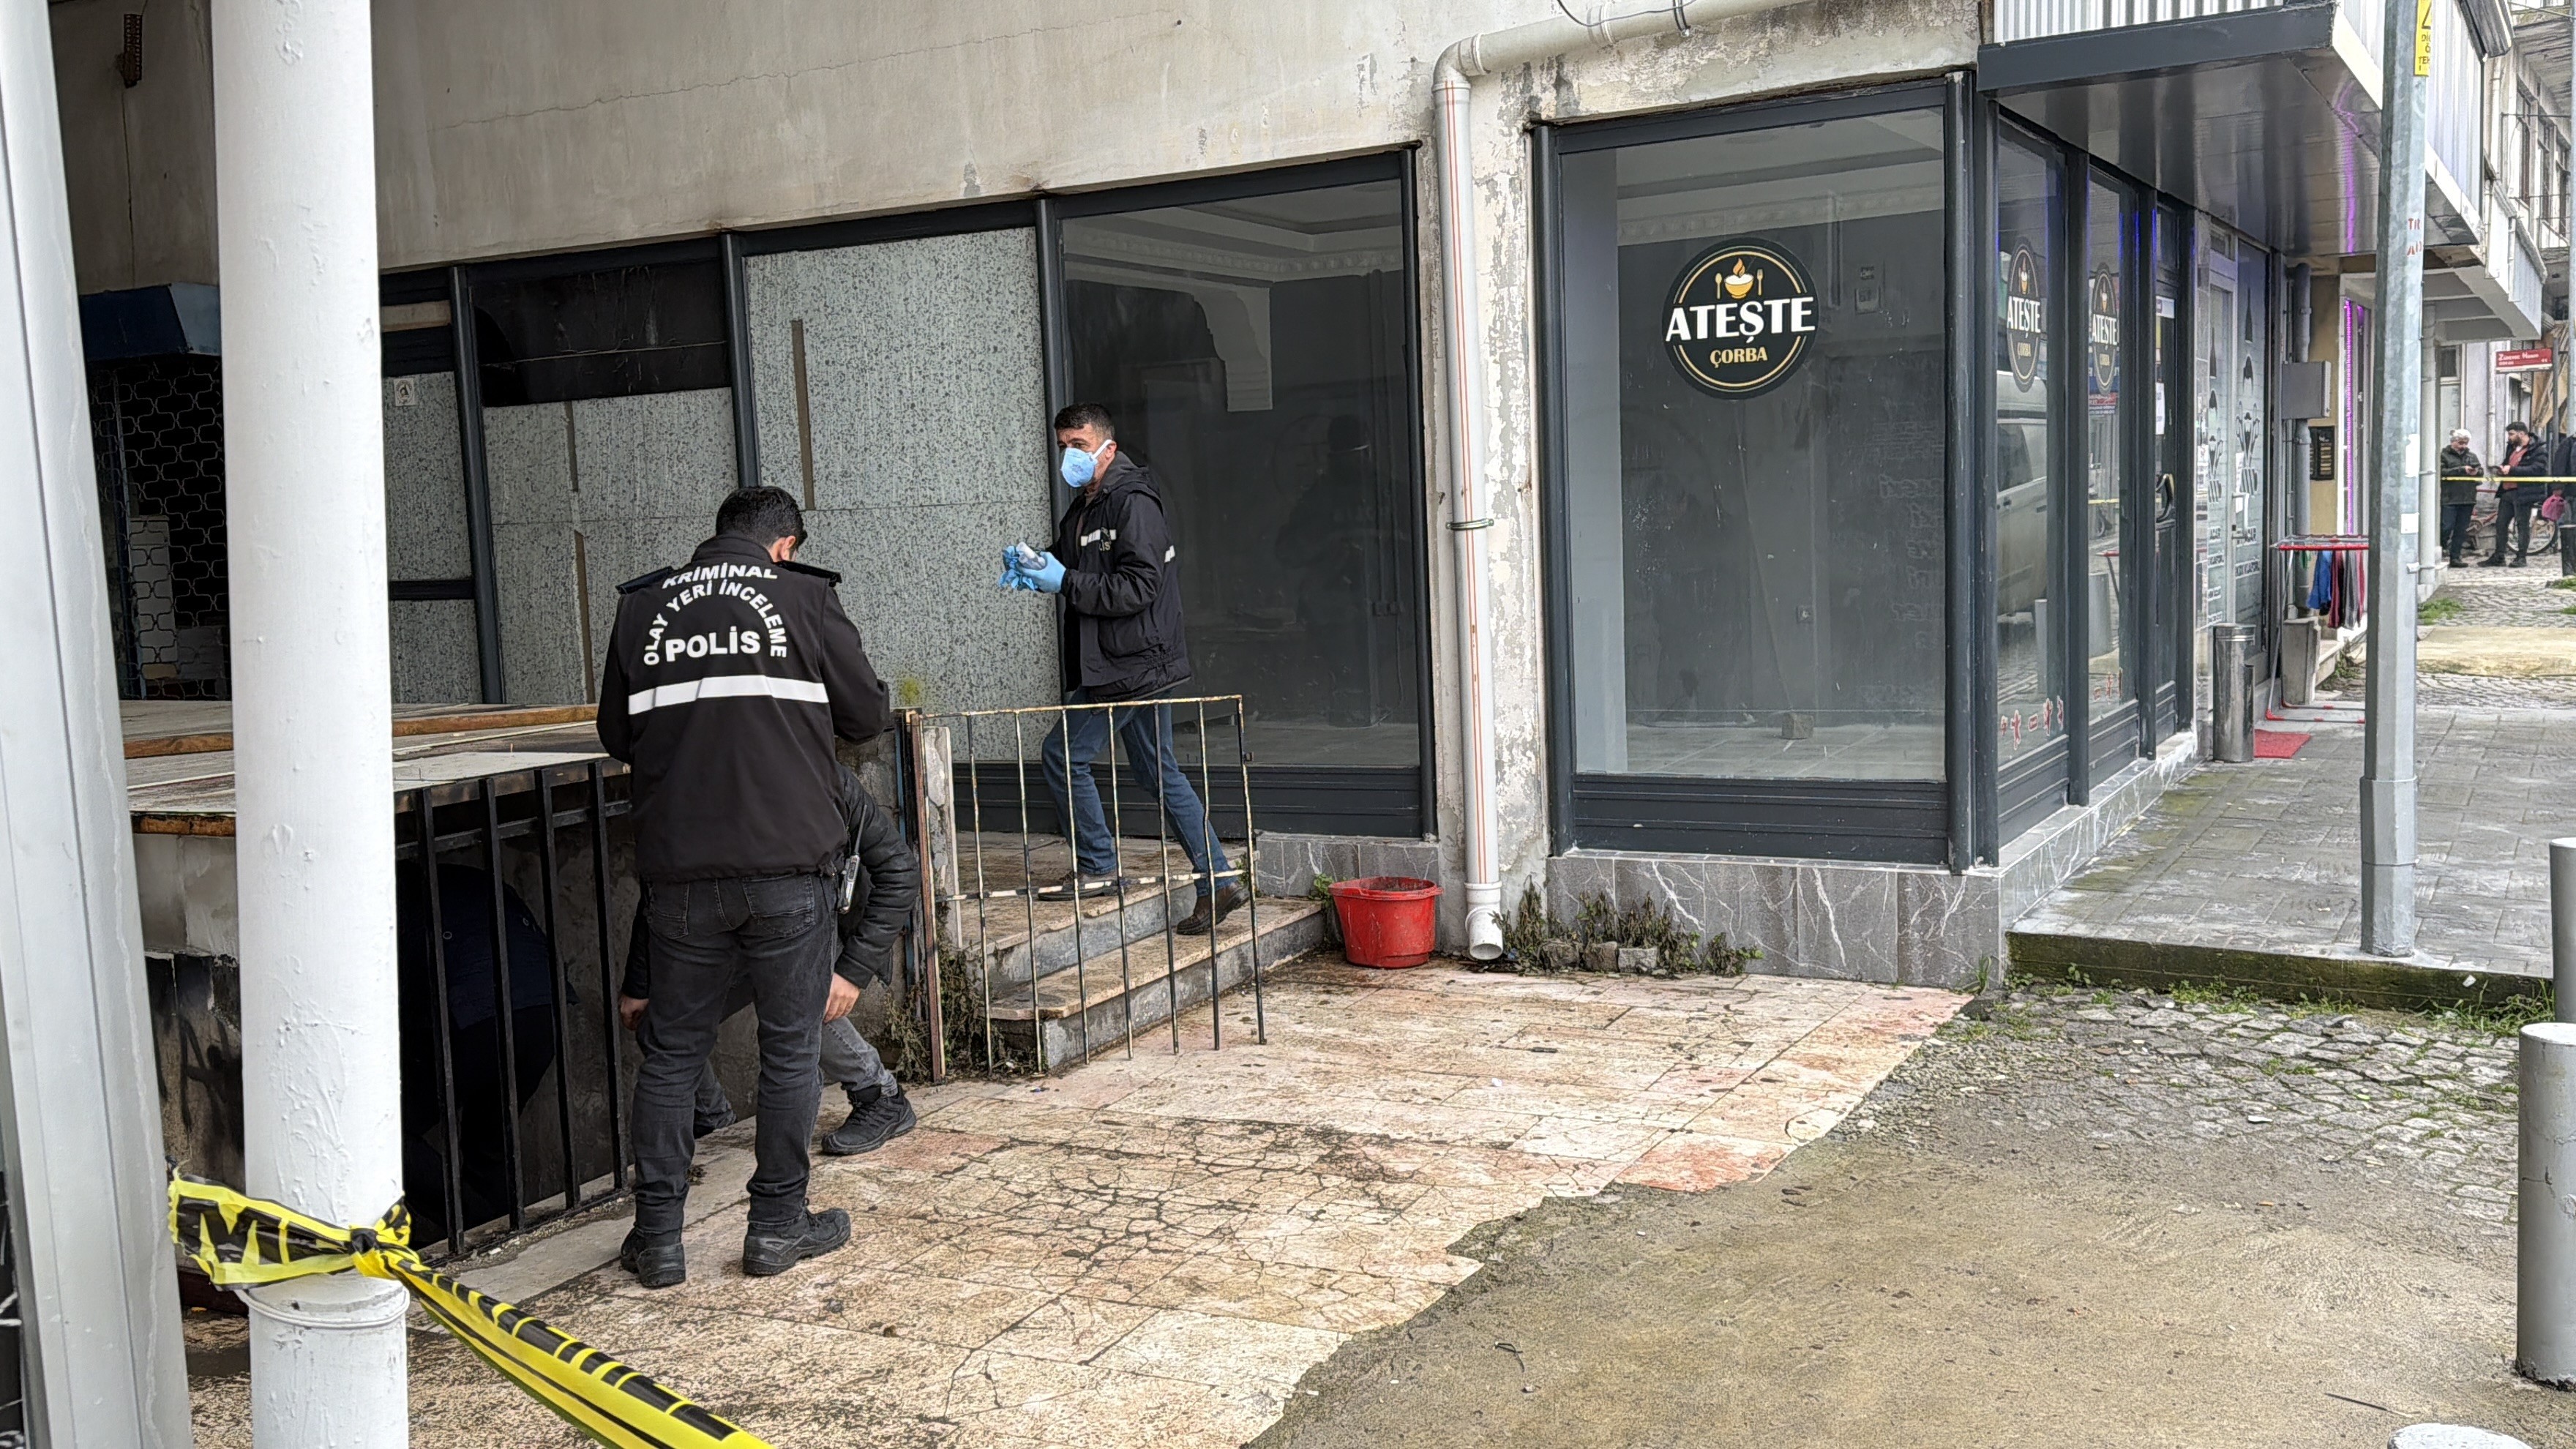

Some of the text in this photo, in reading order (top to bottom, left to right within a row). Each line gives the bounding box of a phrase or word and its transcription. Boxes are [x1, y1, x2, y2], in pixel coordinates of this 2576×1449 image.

[1666, 296, 1816, 343] ATEŞTE
[2007, 296, 2041, 338] ATEŞTE
[2092, 314, 2117, 350] ATEŞTE
[1710, 346, 1768, 368] ÇORBA
[662, 562, 778, 590] KRİMİNAL
[643, 579, 787, 666] OLAY YERİ İNCELEME
[665, 626, 761, 662] POLİS
